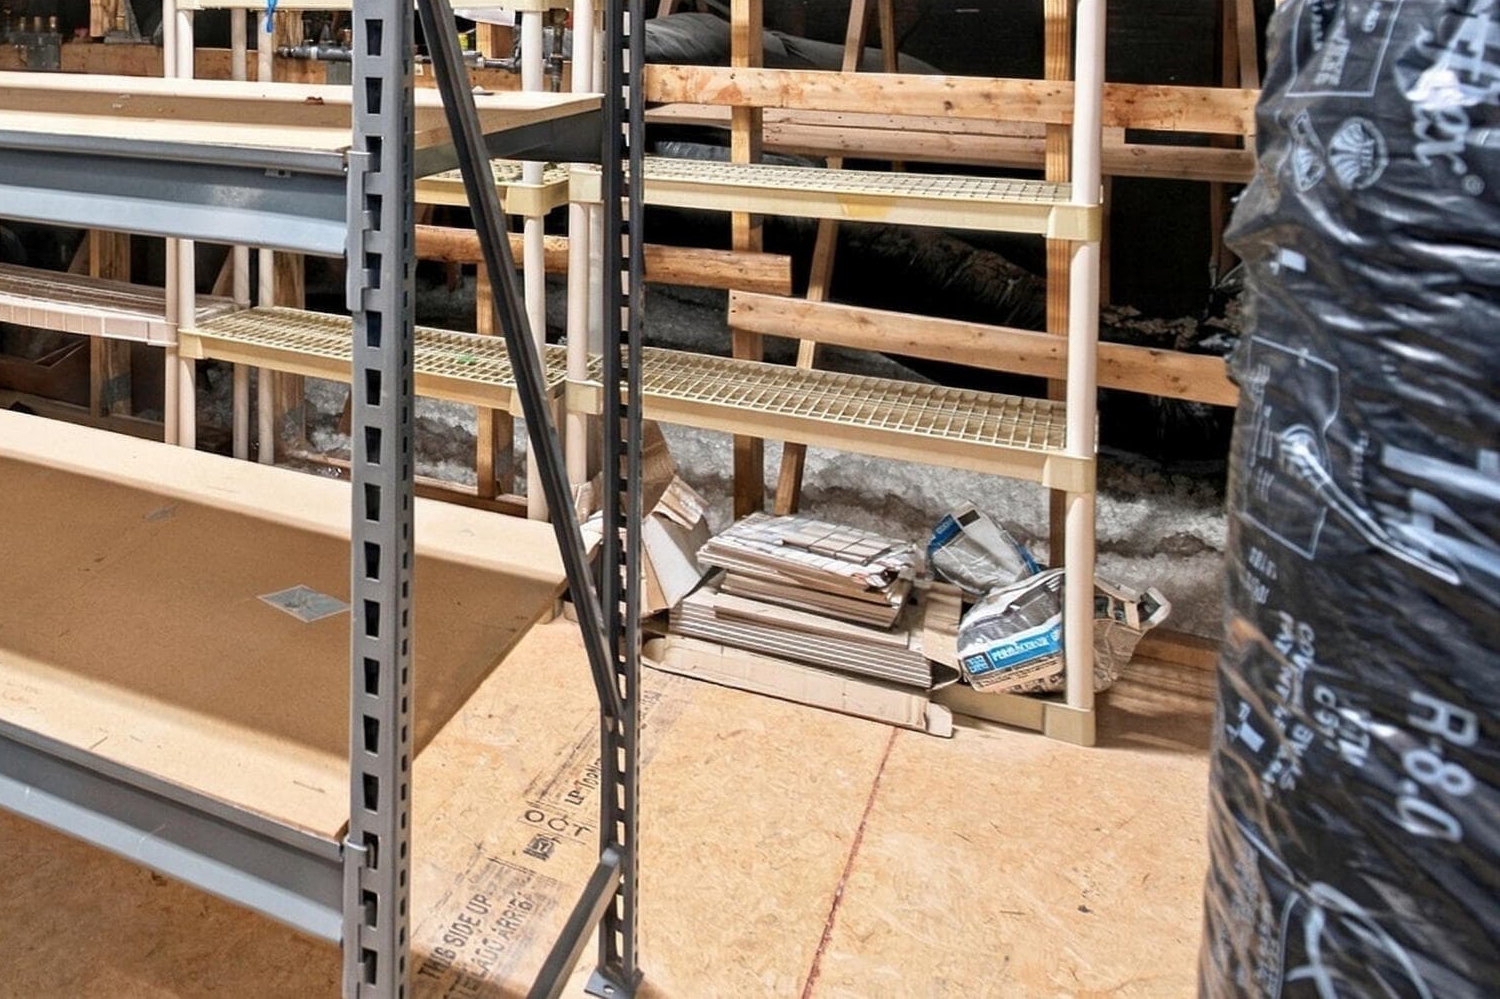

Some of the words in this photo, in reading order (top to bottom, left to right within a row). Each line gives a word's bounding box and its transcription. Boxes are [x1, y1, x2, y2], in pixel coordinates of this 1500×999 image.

[524, 809, 592, 838] OCT
[443, 912, 482, 948] SIDE
[465, 892, 492, 916] UP
